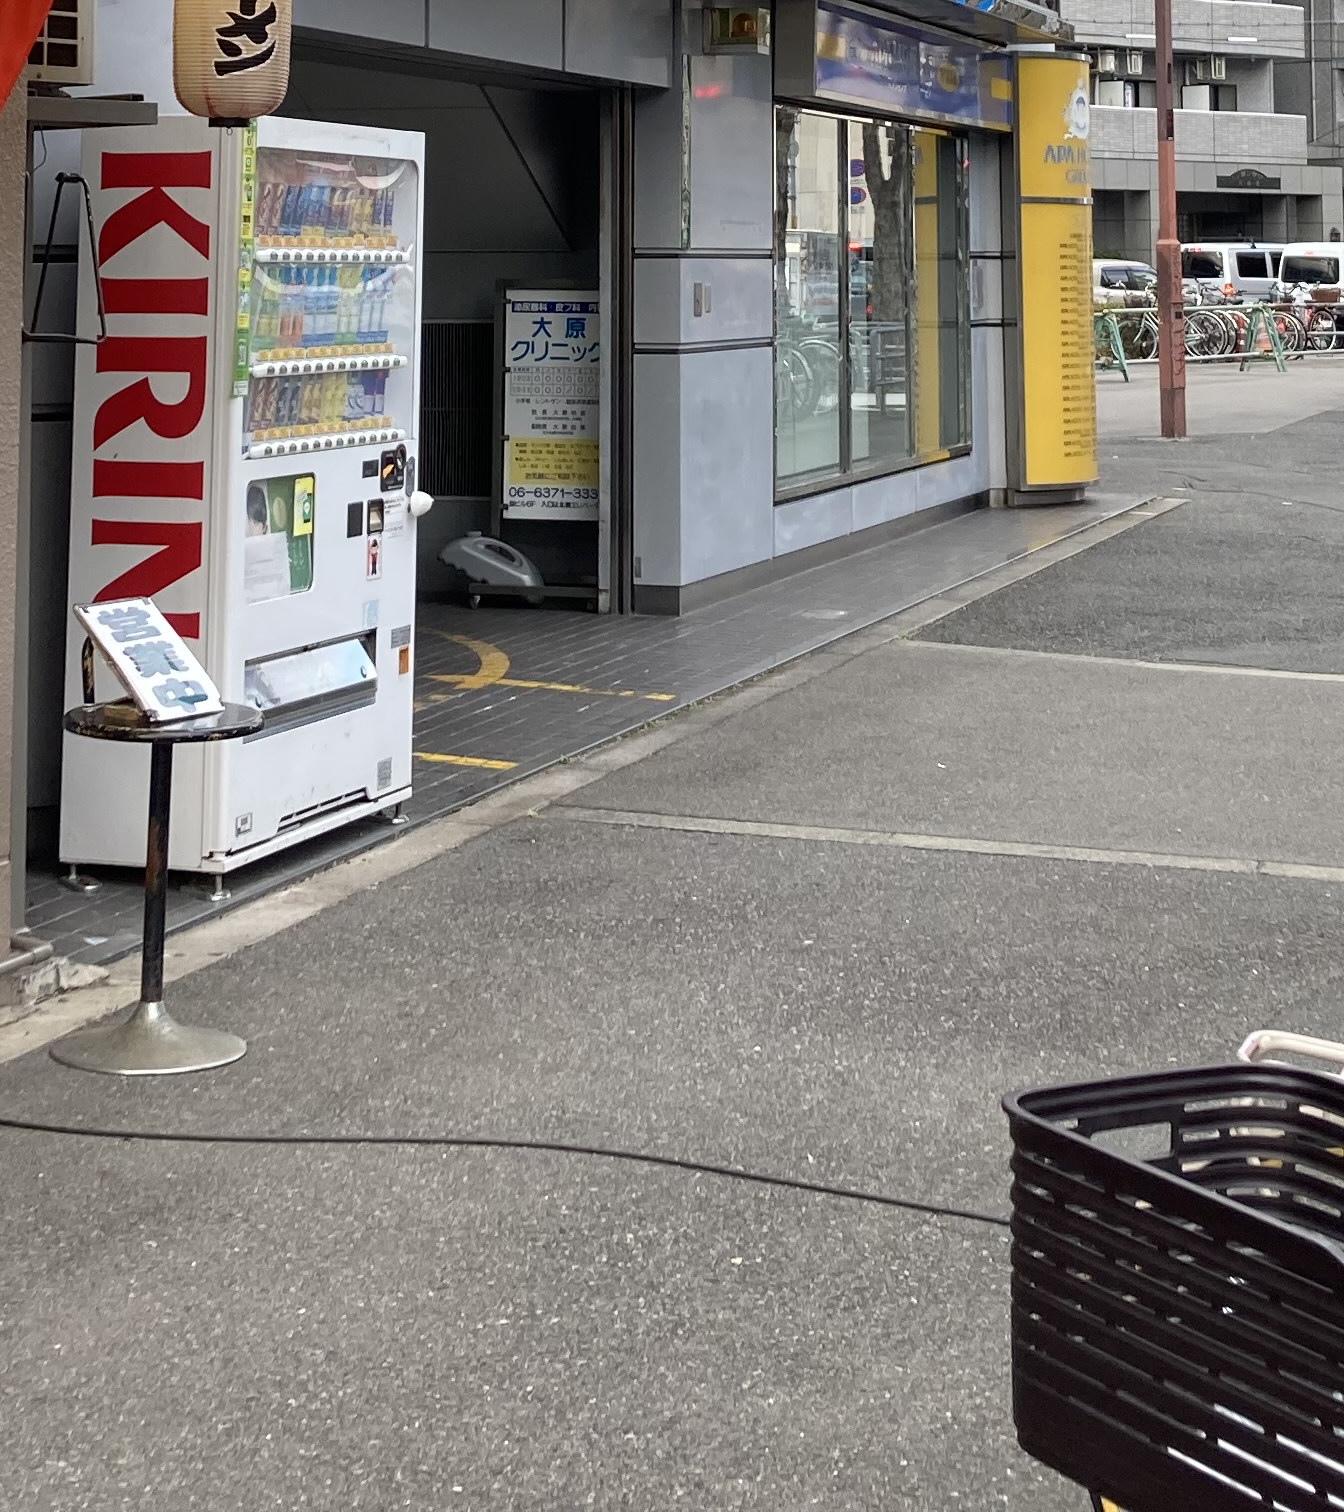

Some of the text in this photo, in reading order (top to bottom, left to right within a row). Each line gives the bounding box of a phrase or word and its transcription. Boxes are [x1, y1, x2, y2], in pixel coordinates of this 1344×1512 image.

[511, 340, 600, 362] クリニック
[531, 316, 587, 339] 大原
[90, 149, 213, 640] KIRIN
[97, 606, 209, 713] 営業中
